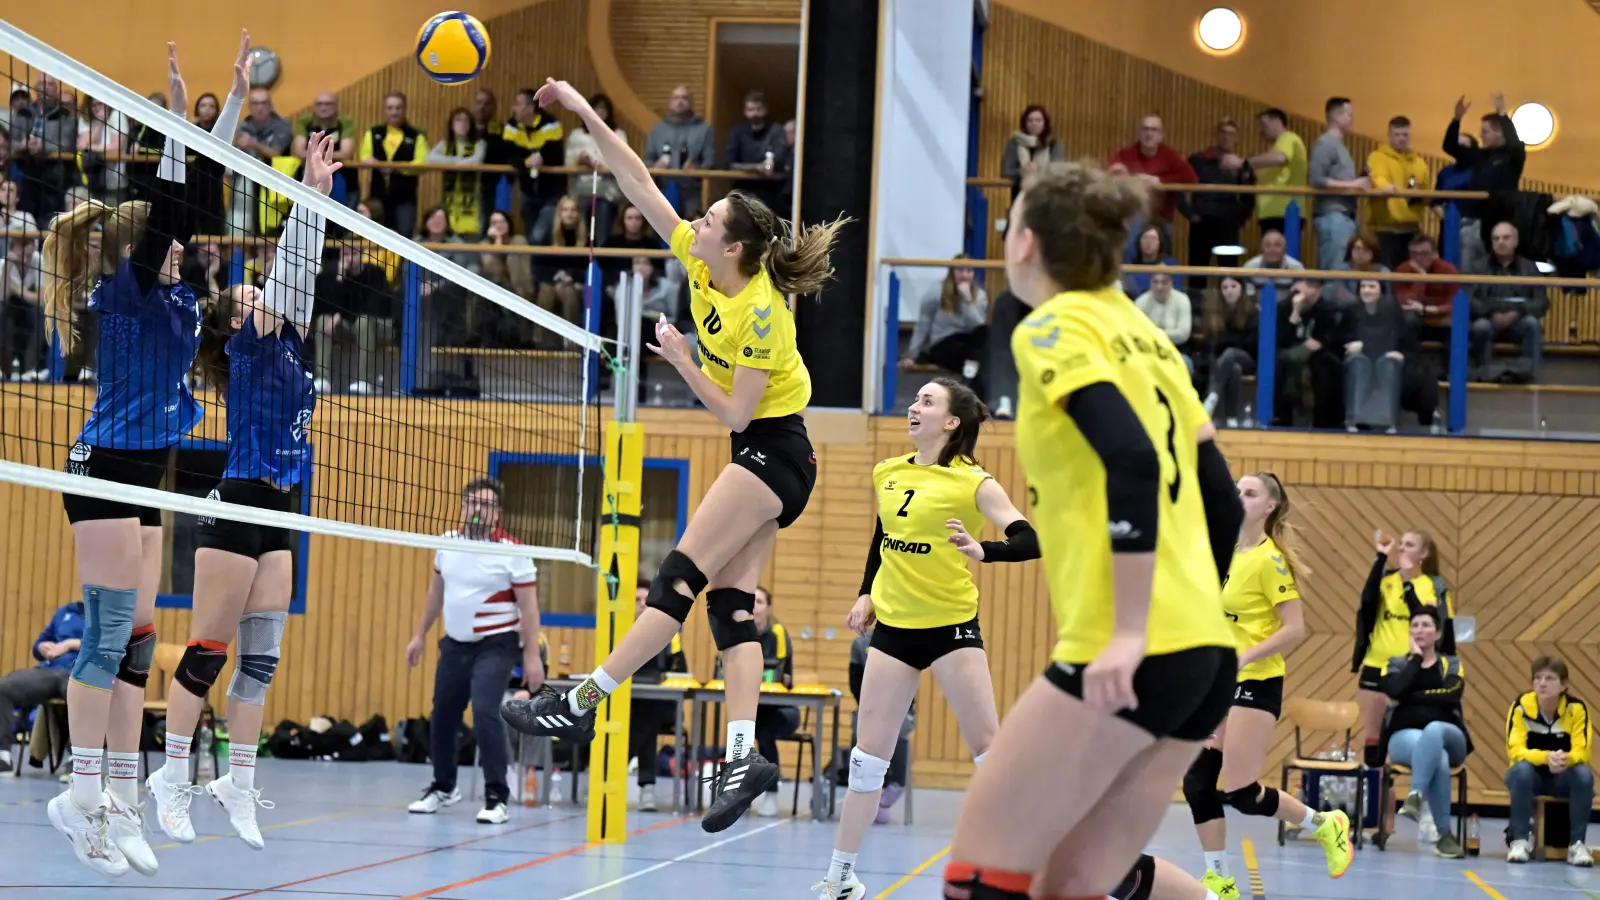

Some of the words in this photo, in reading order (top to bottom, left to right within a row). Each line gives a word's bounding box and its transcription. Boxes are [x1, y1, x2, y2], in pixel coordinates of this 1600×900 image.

[702, 305, 722, 335] 10
[896, 489, 915, 517] 2
[882, 533, 932, 554] ONRAD
